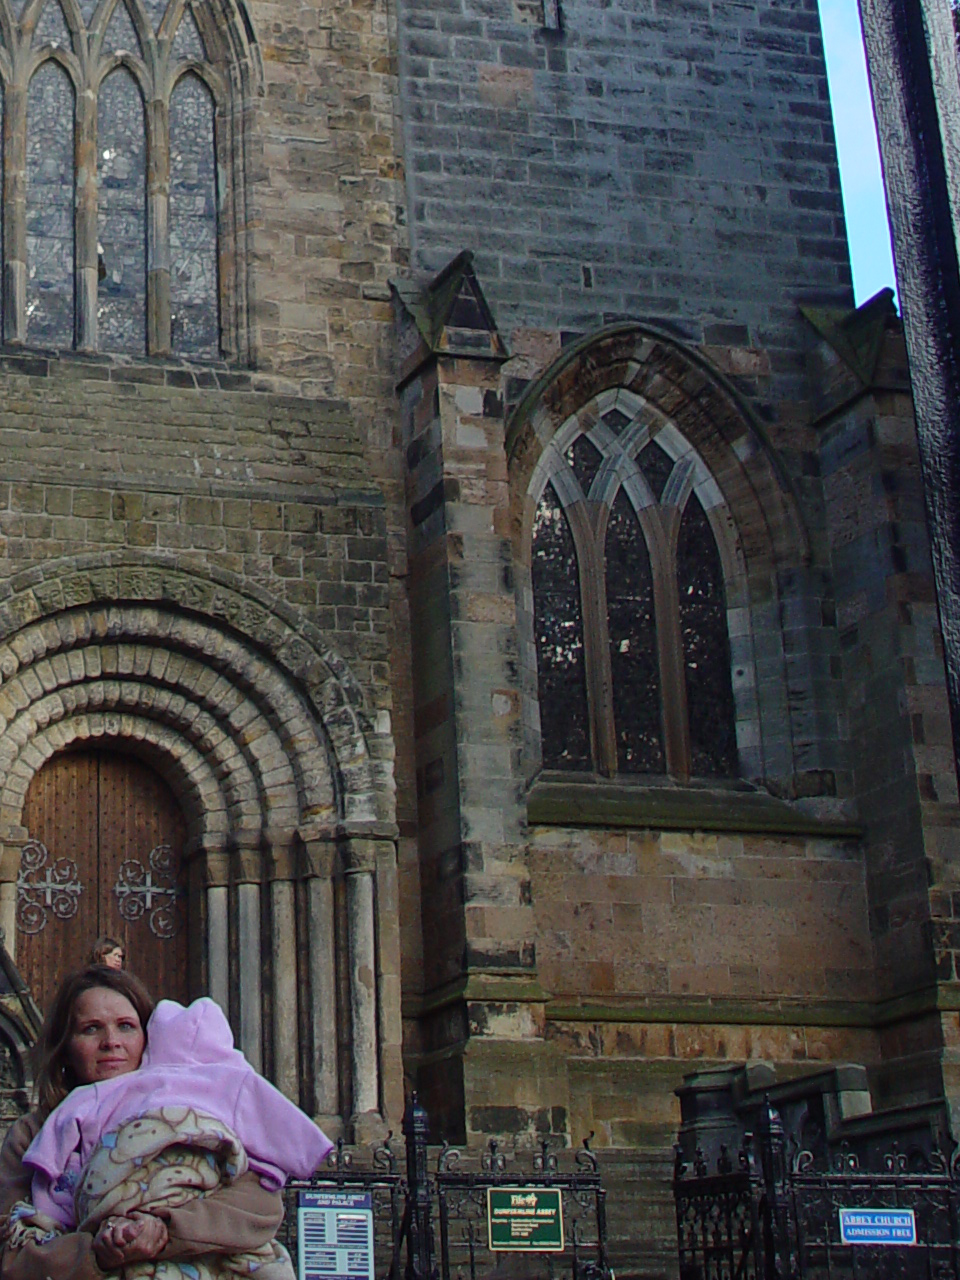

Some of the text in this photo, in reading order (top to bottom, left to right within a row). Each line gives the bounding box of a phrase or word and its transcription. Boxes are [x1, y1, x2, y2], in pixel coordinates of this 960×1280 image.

[536, 1208, 557, 1216] ABBEY
[844, 1215, 911, 1226] ABBEY CHURCH
[846, 1228, 911, 1237] ADMISSION FREE
